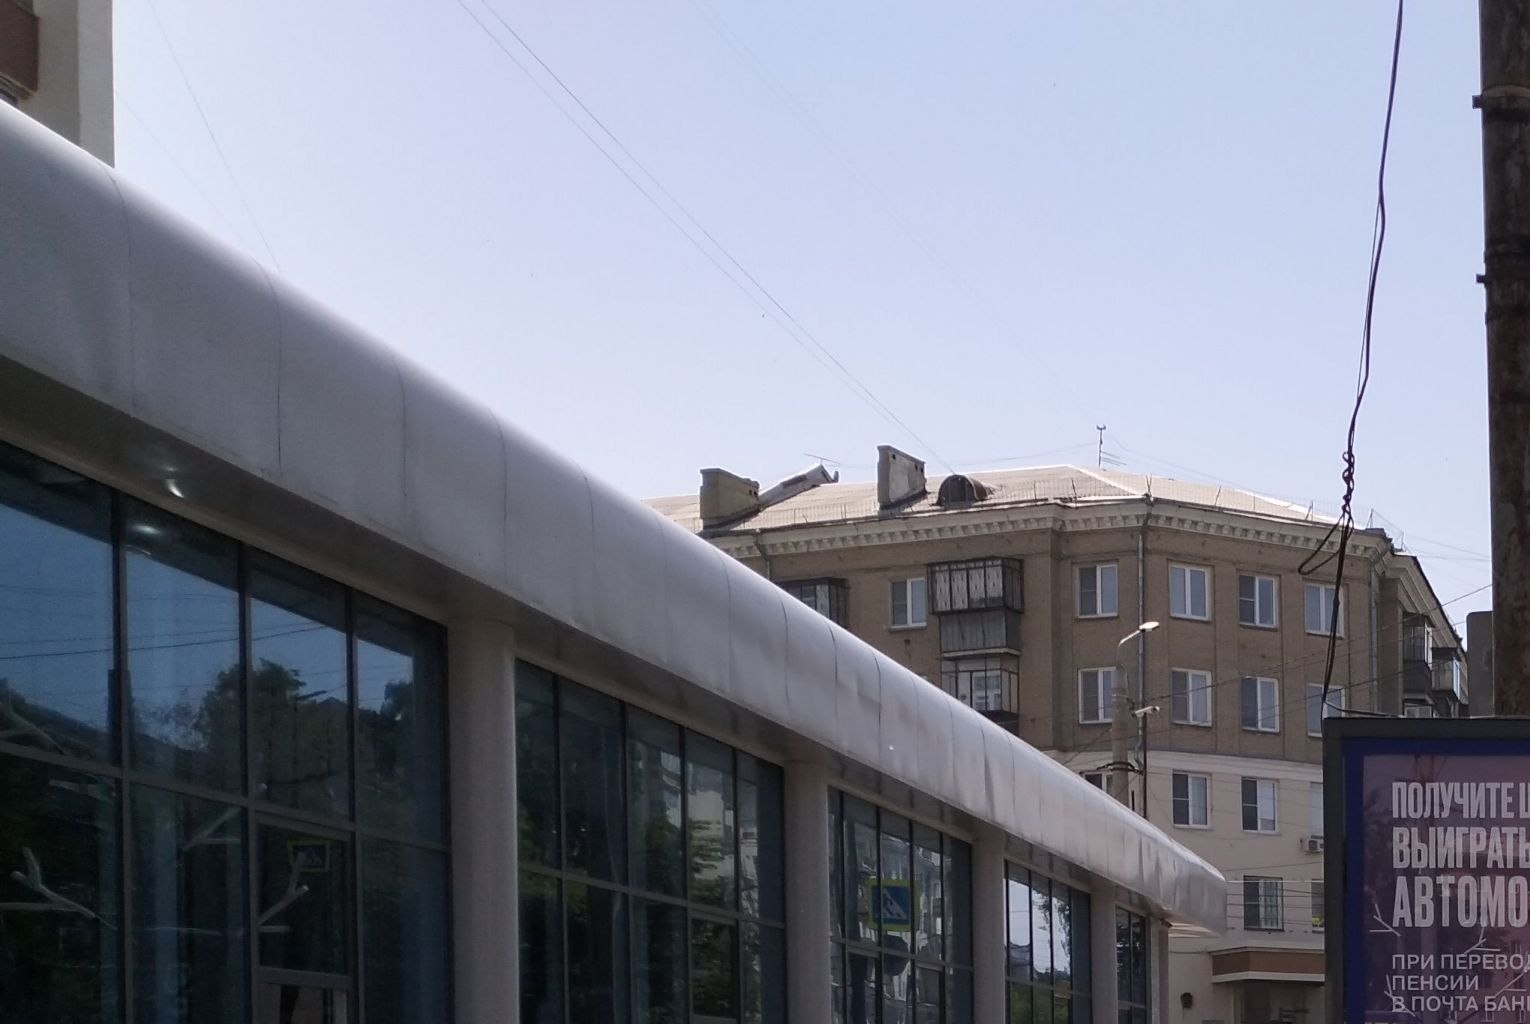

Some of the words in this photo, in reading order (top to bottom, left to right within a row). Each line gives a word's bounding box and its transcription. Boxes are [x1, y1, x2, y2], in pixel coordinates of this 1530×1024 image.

[1391, 781, 1515, 819] ПОЛУЧИТЕ
[1391, 954, 1435, 971] ПРИ
[1391, 974, 1479, 991] ПЕНСИИ
[1391, 995, 1405, 1012] В
[1410, 995, 1479, 1012] ПОЧТА
